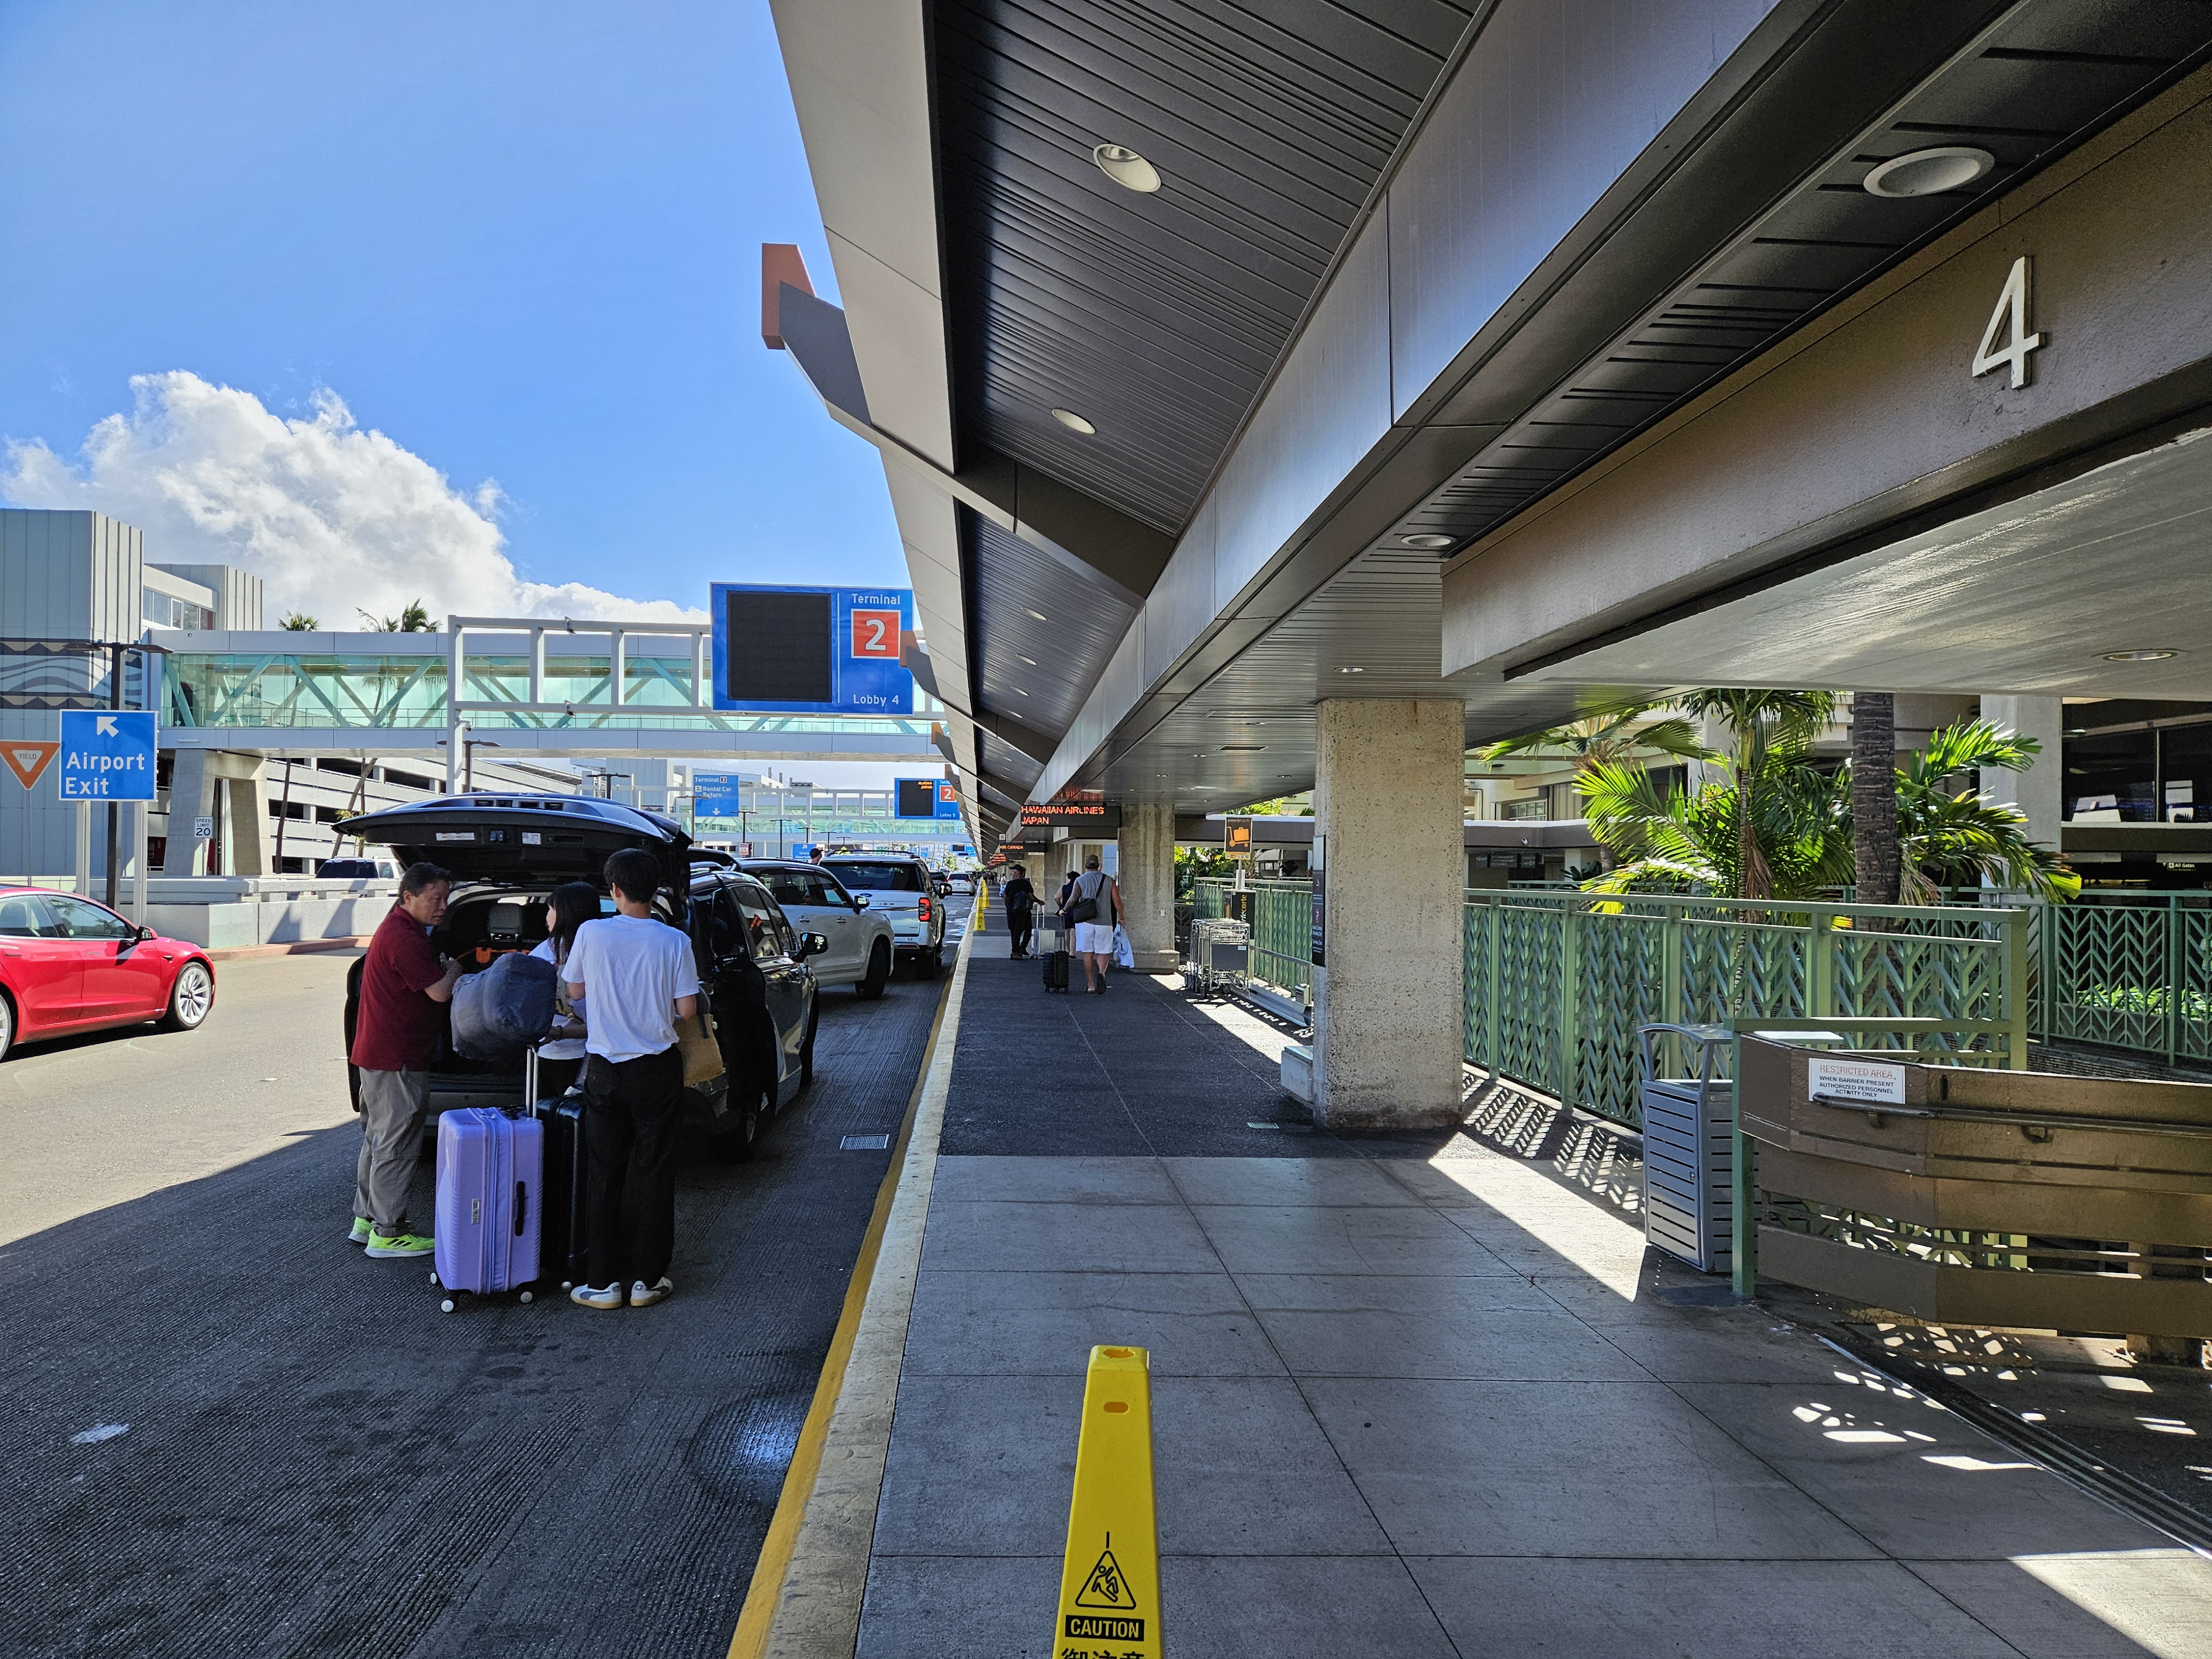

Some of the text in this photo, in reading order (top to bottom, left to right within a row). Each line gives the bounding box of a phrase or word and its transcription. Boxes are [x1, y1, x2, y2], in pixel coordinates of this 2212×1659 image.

[1972, 256, 2041, 389] 4
[852, 593, 900, 605] Terminal
[865, 618, 886, 651] 2
[853, 694, 899, 707] Lobby 4
[66, 752, 145, 774] Airport
[65, 777, 109, 795] Exit
[944, 789, 952, 799] 2
[1021, 806, 1104, 815] HAWAIIAN AIRLINES
[1021, 816, 1049, 825] JAPAN
[196, 827, 211, 836] 20
[1820, 1065, 1869, 1076] RESTRICTED
[1819, 1082, 1856, 1091] AUTHORIZED
[1071, 1618, 1139, 1638] CAUTION
